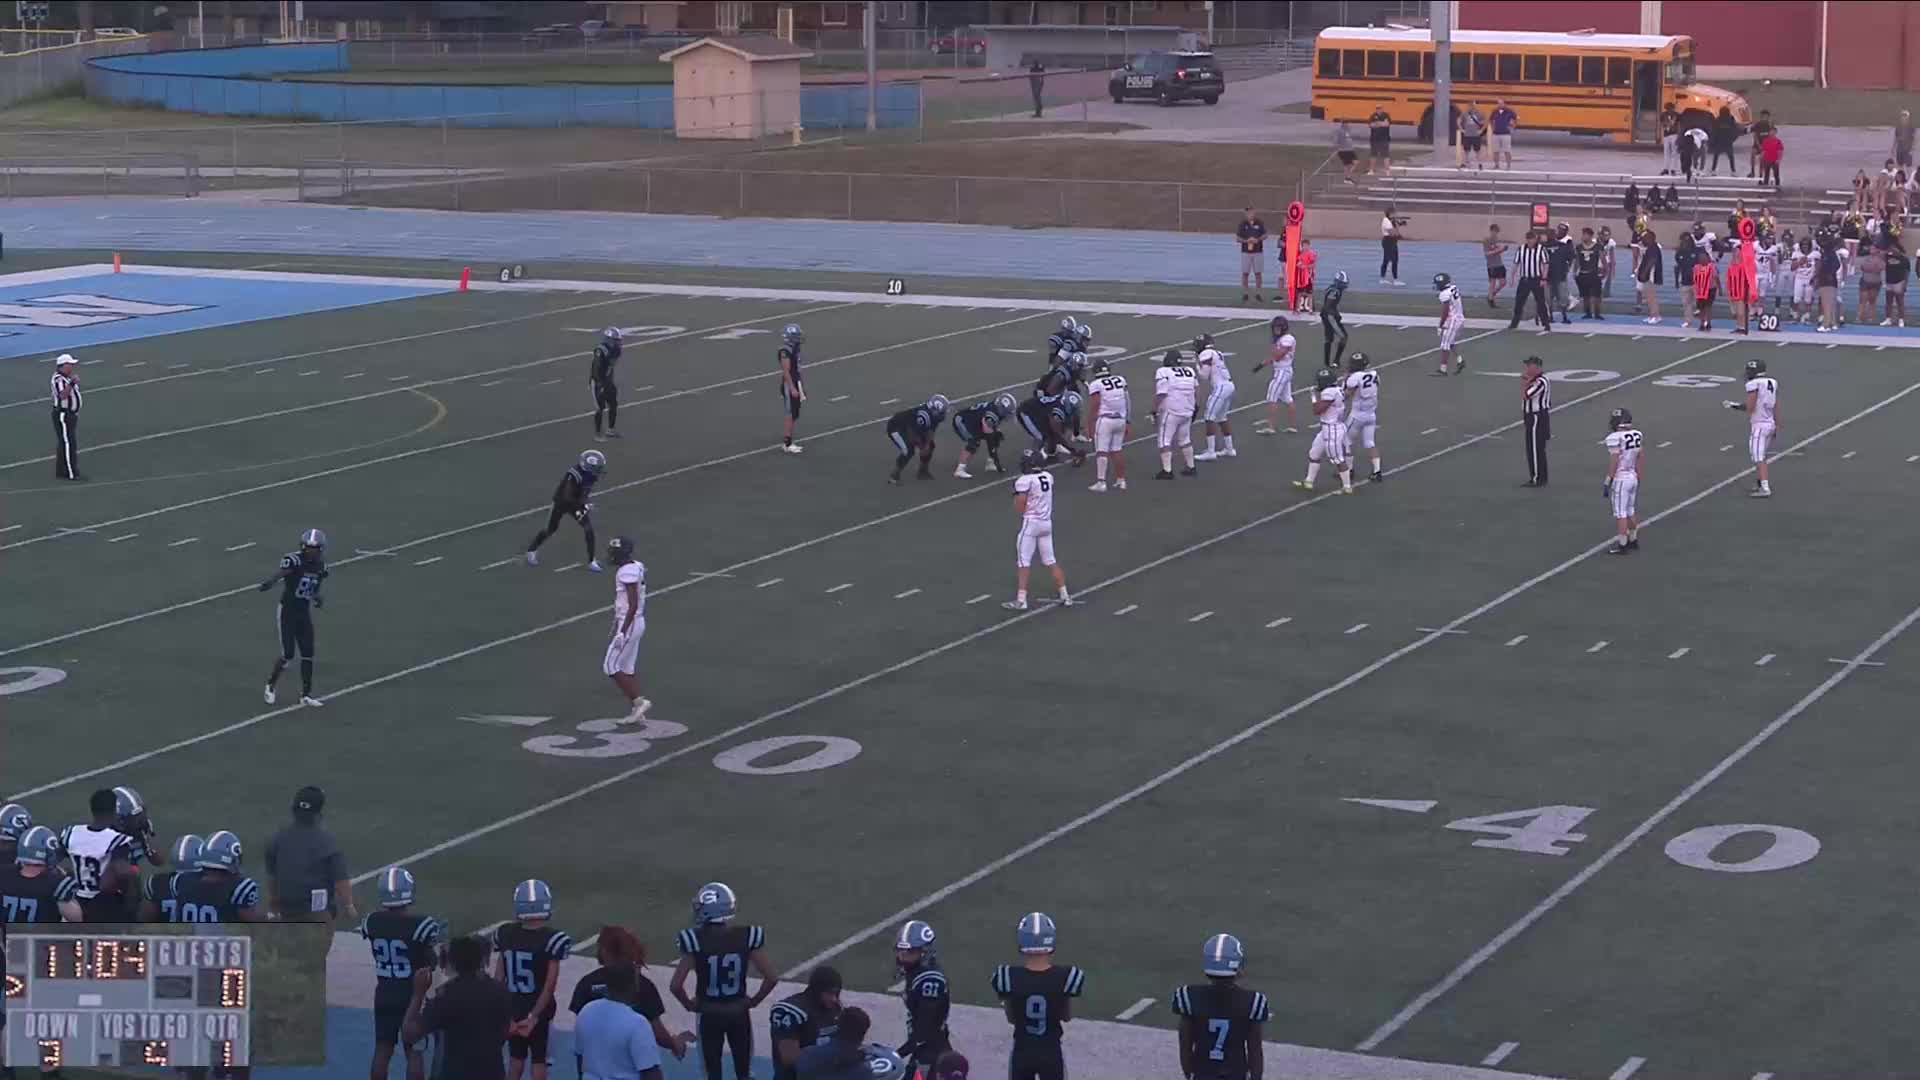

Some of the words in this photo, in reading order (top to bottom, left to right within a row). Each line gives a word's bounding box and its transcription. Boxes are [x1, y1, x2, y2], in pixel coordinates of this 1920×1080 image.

[888, 280, 902, 293] 10
[1760, 314, 1777, 330] 30
[1101, 376, 1123, 391] 92
[1767, 379, 1774, 393] 4
[1624, 432, 1641, 450] 22
[1038, 475, 1050, 492] 6
[73, 854, 101, 890] 13
[699, 890, 718, 904] G
[3, 895, 38, 922] 77
[503, 950, 536, 993] 15
[706, 953, 742, 997] 13
[772, 1013, 792, 1028] 54
[1026, 995, 1047, 1036] 9
[1208, 1018, 1230, 1060] 7
